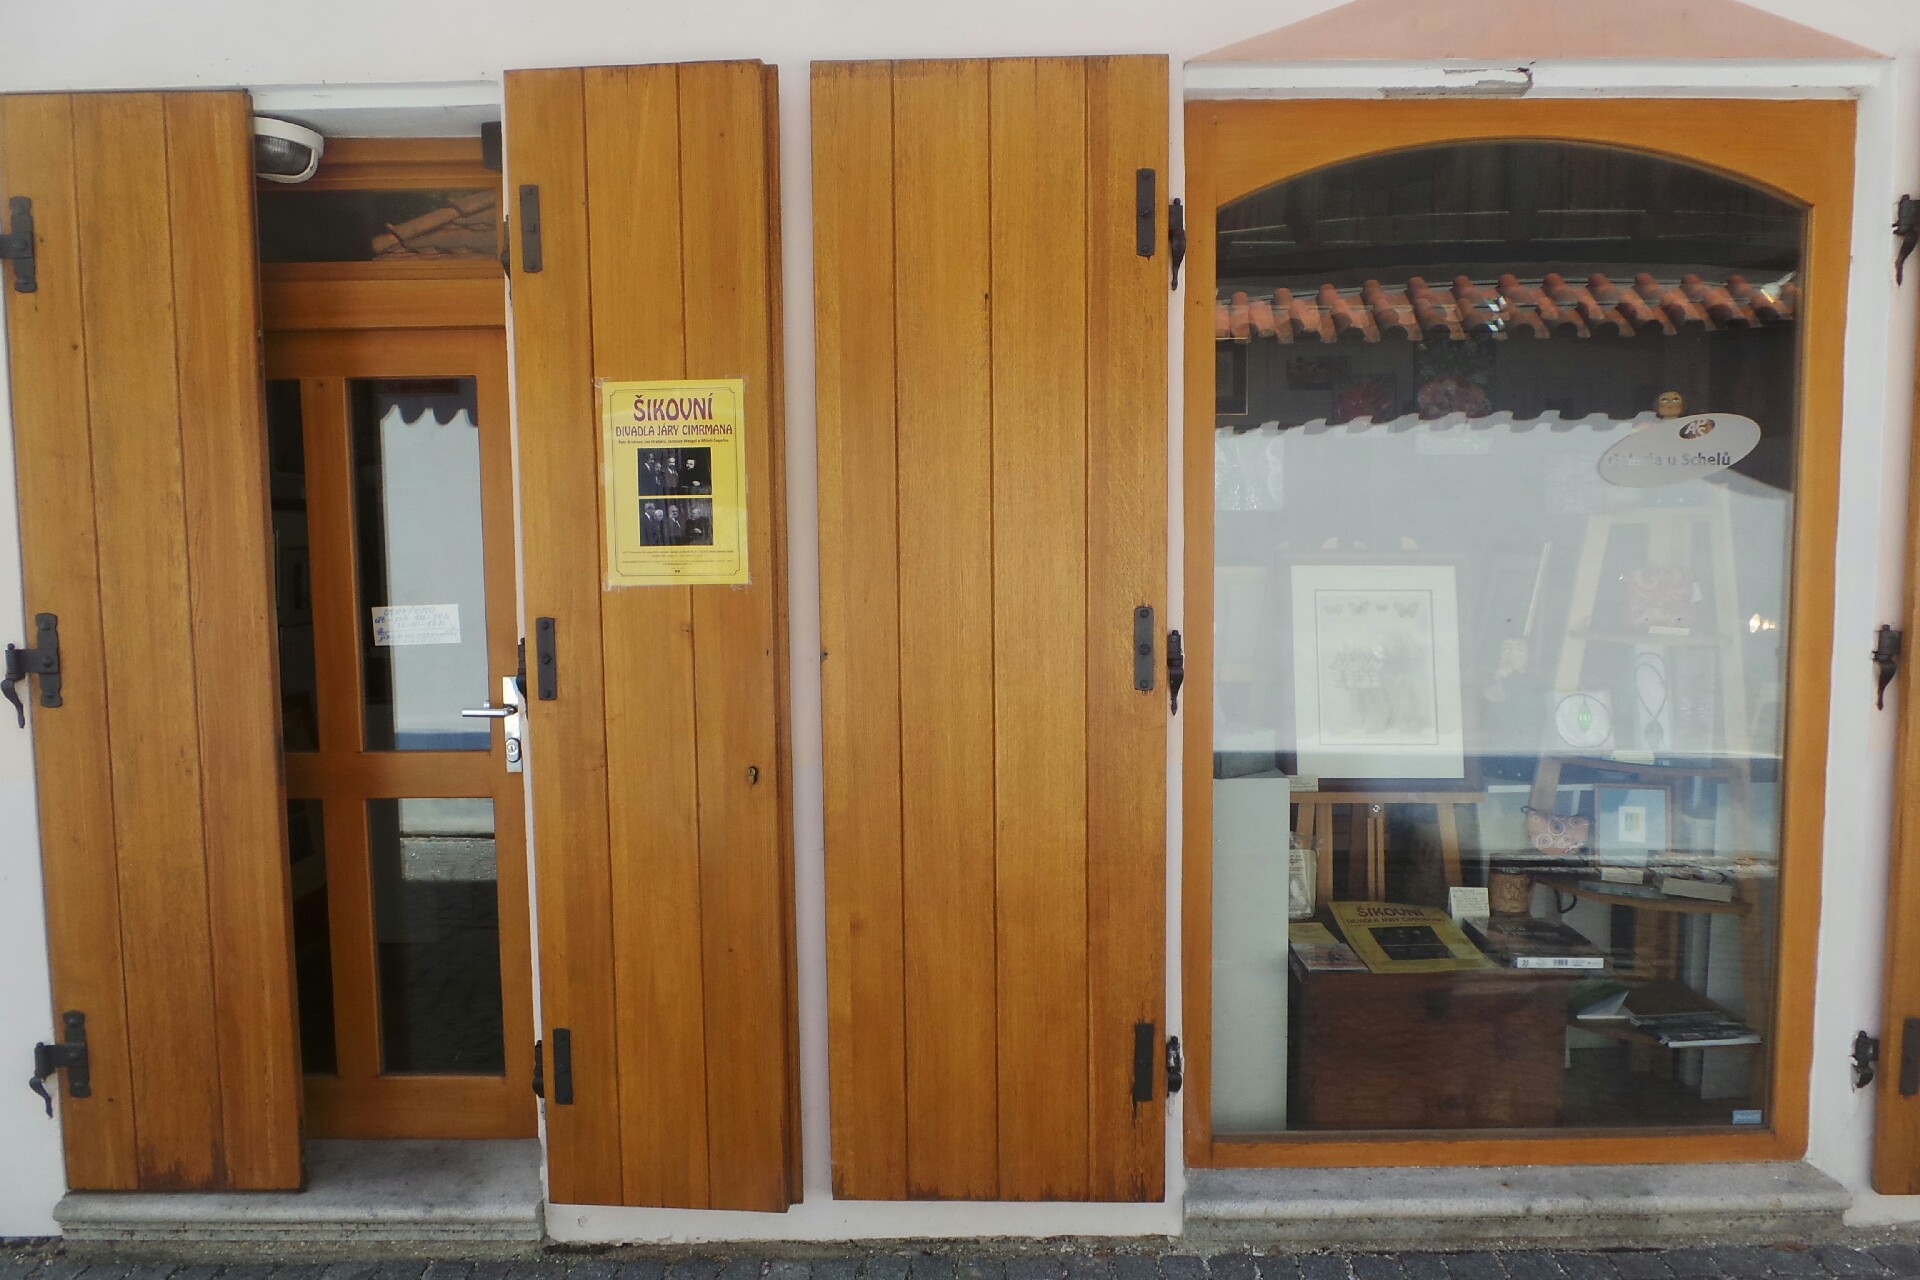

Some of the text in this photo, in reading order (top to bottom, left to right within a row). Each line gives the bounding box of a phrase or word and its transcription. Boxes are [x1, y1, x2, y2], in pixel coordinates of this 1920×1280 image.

[633, 393, 713, 421] ŠIKOVNÍ
[616, 423, 733, 437] DIVADLA JÁRY CIMRMANA
[1667, 457, 1676, 465] u
[1681, 451, 1731, 466] Schelů
